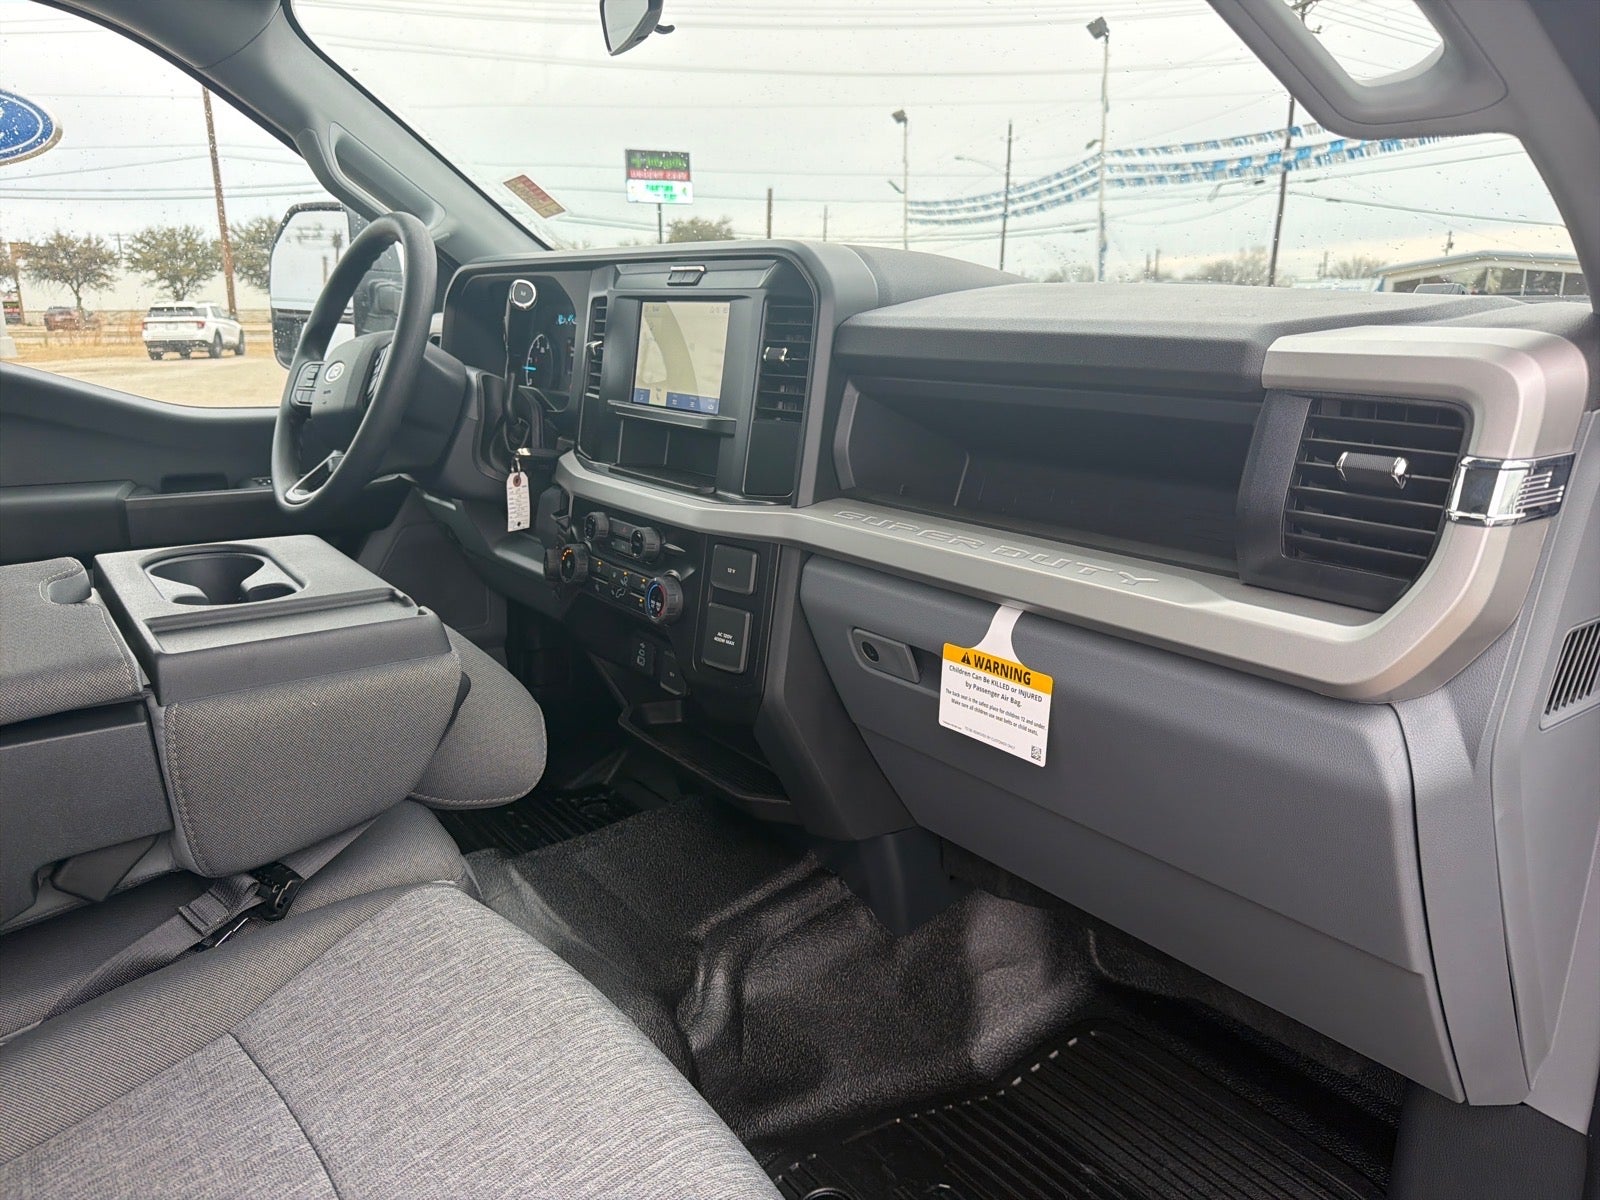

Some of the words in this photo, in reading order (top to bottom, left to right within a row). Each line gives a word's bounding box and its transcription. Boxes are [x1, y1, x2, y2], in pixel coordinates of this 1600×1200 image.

[833, 511, 985, 549] SUPER
[991, 545, 1160, 586] DUTY
[949, 665, 971, 678] Children
[971, 672, 982, 681] Can
[983, 676, 991, 684] Be
[991, 680, 1010, 691] KILLED
[1018, 689, 1043, 703] INJURED
[974, 654, 1031, 686] WARNING
[965, 681, 973, 690] by
[973, 683, 1000, 698] Passenger
[1000, 694, 1009, 702] Air
[1010, 697, 1022, 708] Bag.
[951, 698, 961, 706] Make
[974, 705, 988, 716] children
[1003, 715, 1013, 726] belts
[1018, 722, 1027, 731] child
[989, 703, 999, 712] place
[1005, 709, 1020, 720] children
